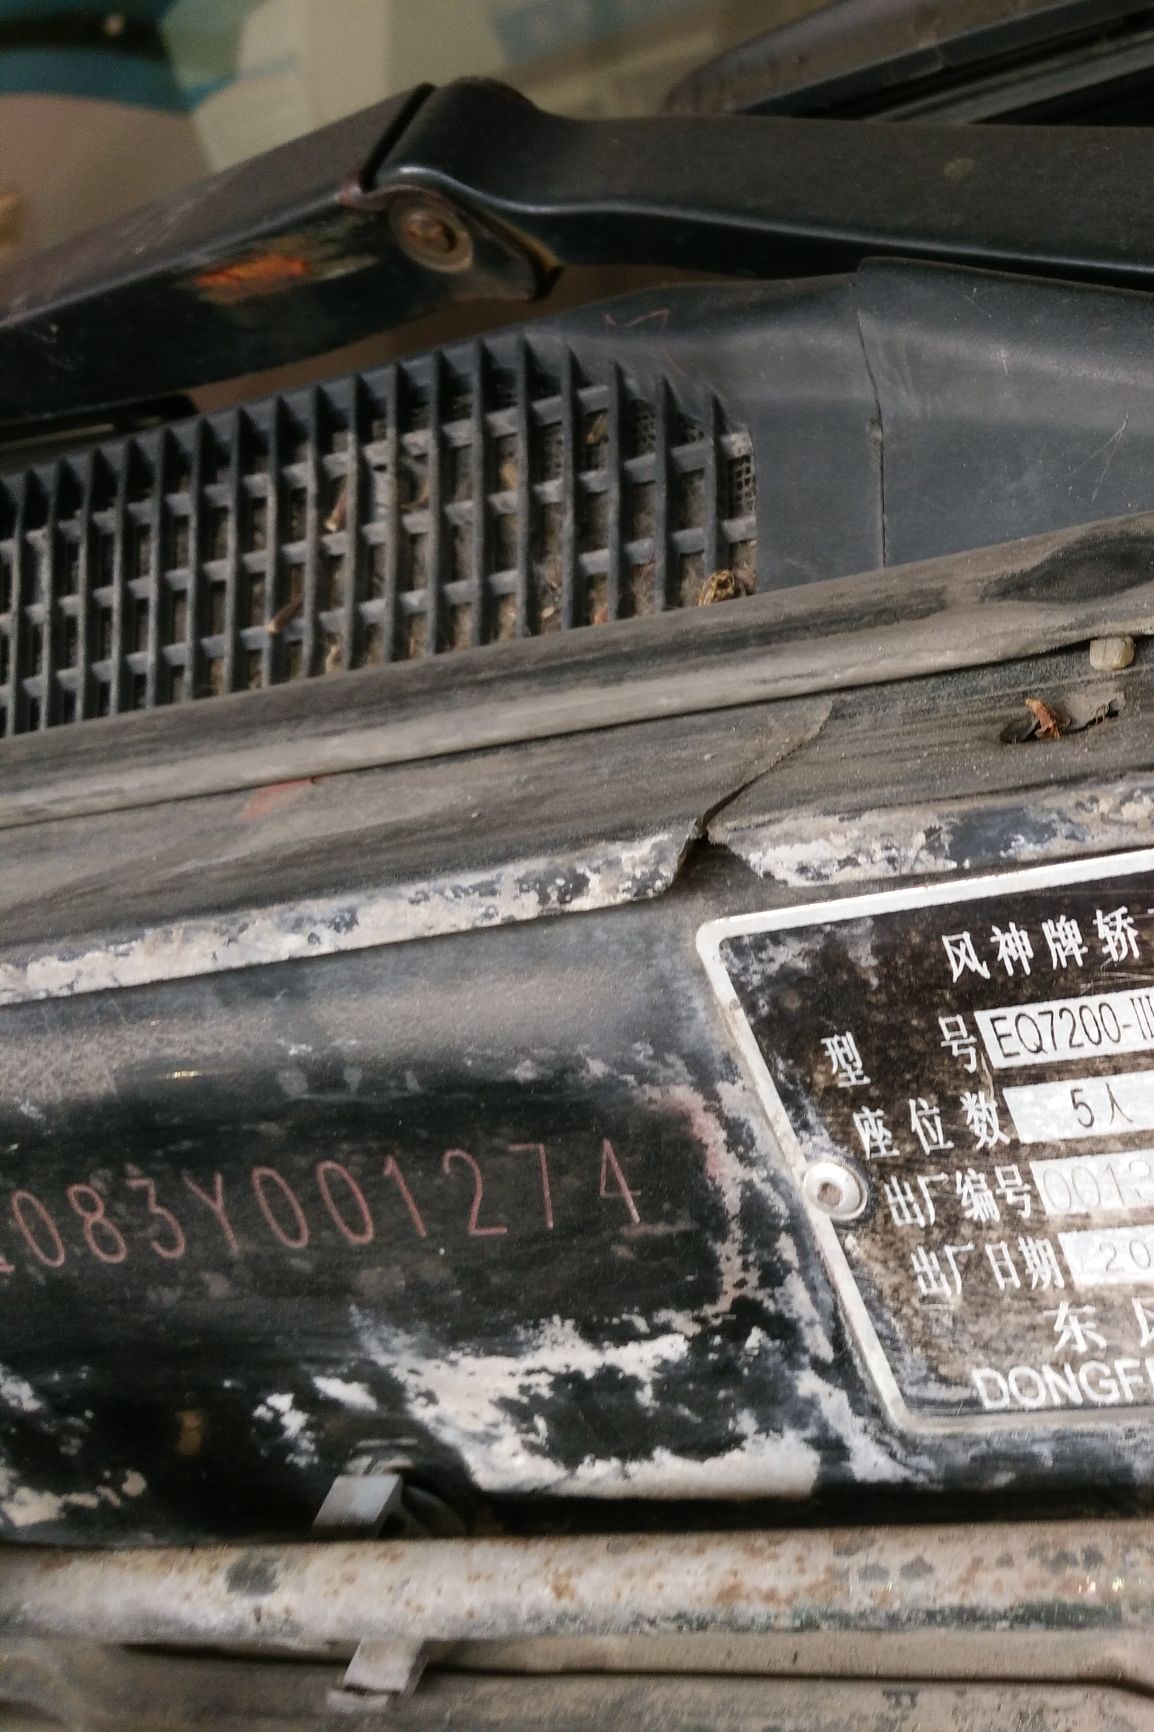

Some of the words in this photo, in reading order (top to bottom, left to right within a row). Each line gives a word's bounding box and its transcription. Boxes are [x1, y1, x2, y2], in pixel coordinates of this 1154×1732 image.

[852, 1090, 1011, 1160] 座位数
[1070, 1082, 1134, 1129] 5人
[0, 1138, 642, 1273] 083Y001274
[883, 1164, 1034, 1228] 出厂编号
[911, 1234, 1066, 1298] 出厂日期
